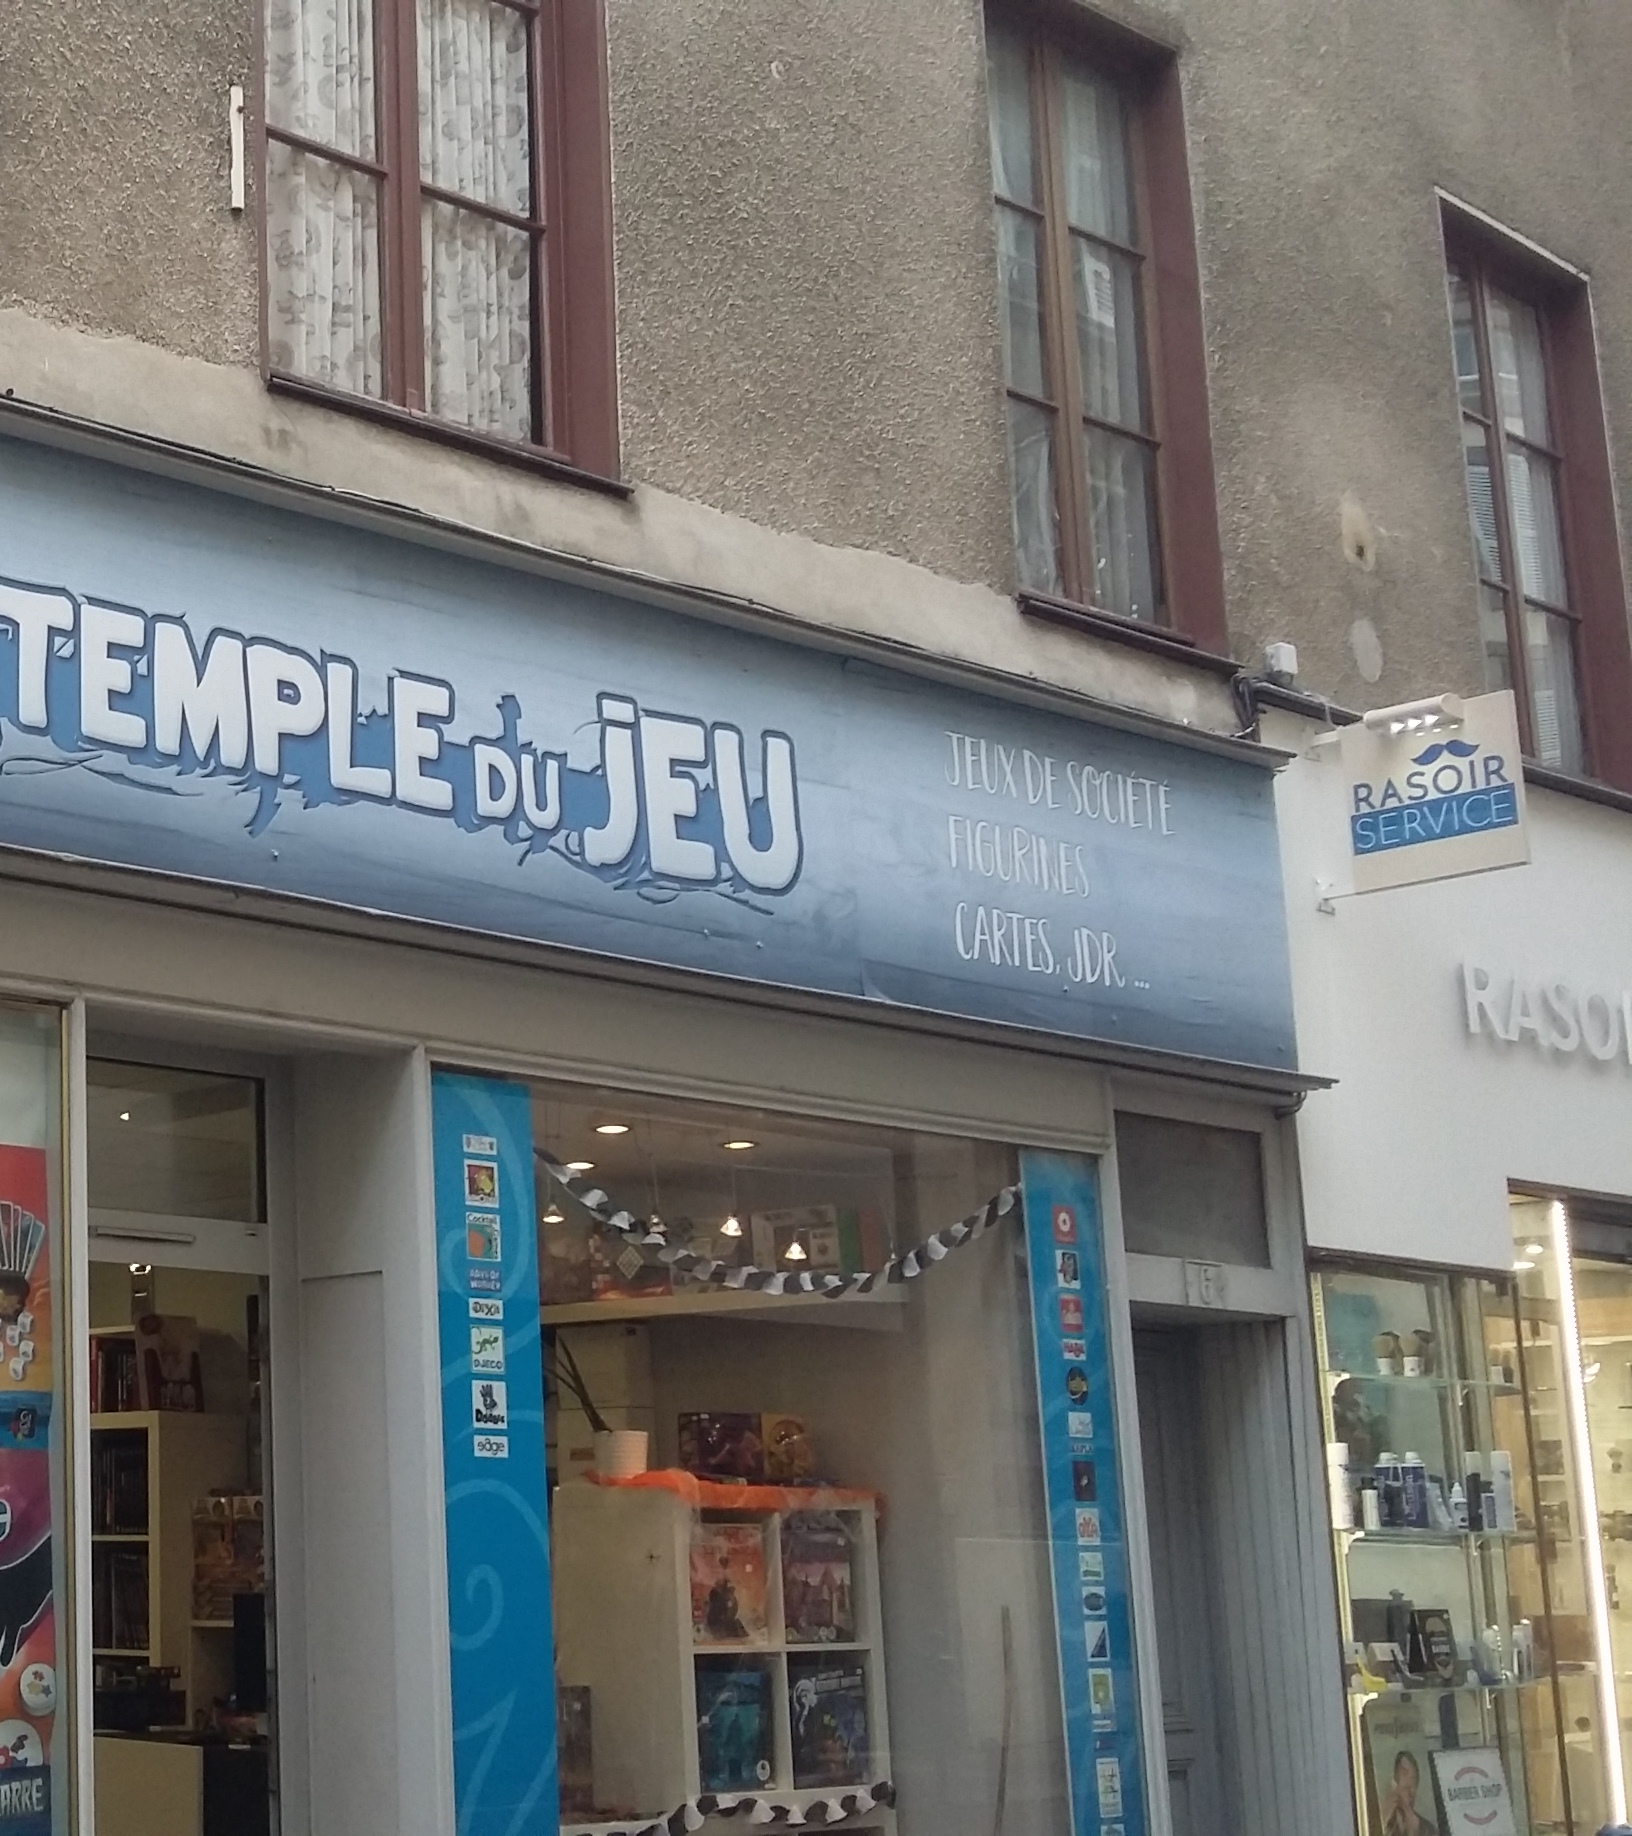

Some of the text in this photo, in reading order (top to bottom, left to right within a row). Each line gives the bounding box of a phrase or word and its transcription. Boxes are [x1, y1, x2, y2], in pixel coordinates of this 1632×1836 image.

[471, 739, 564, 832] DU
[944, 730, 1176, 836] JEUX DE SOCIÉTÉ
[1352, 754, 1509, 814] RASOIR
[1354, 787, 1514, 851] SERVICE
[947, 814, 1090, 898] FIGURINES
[954, 901, 1061, 976] CARTES,
[1067, 926, 1126, 988] JDR
[474, 1358, 503, 1370] DJECO
